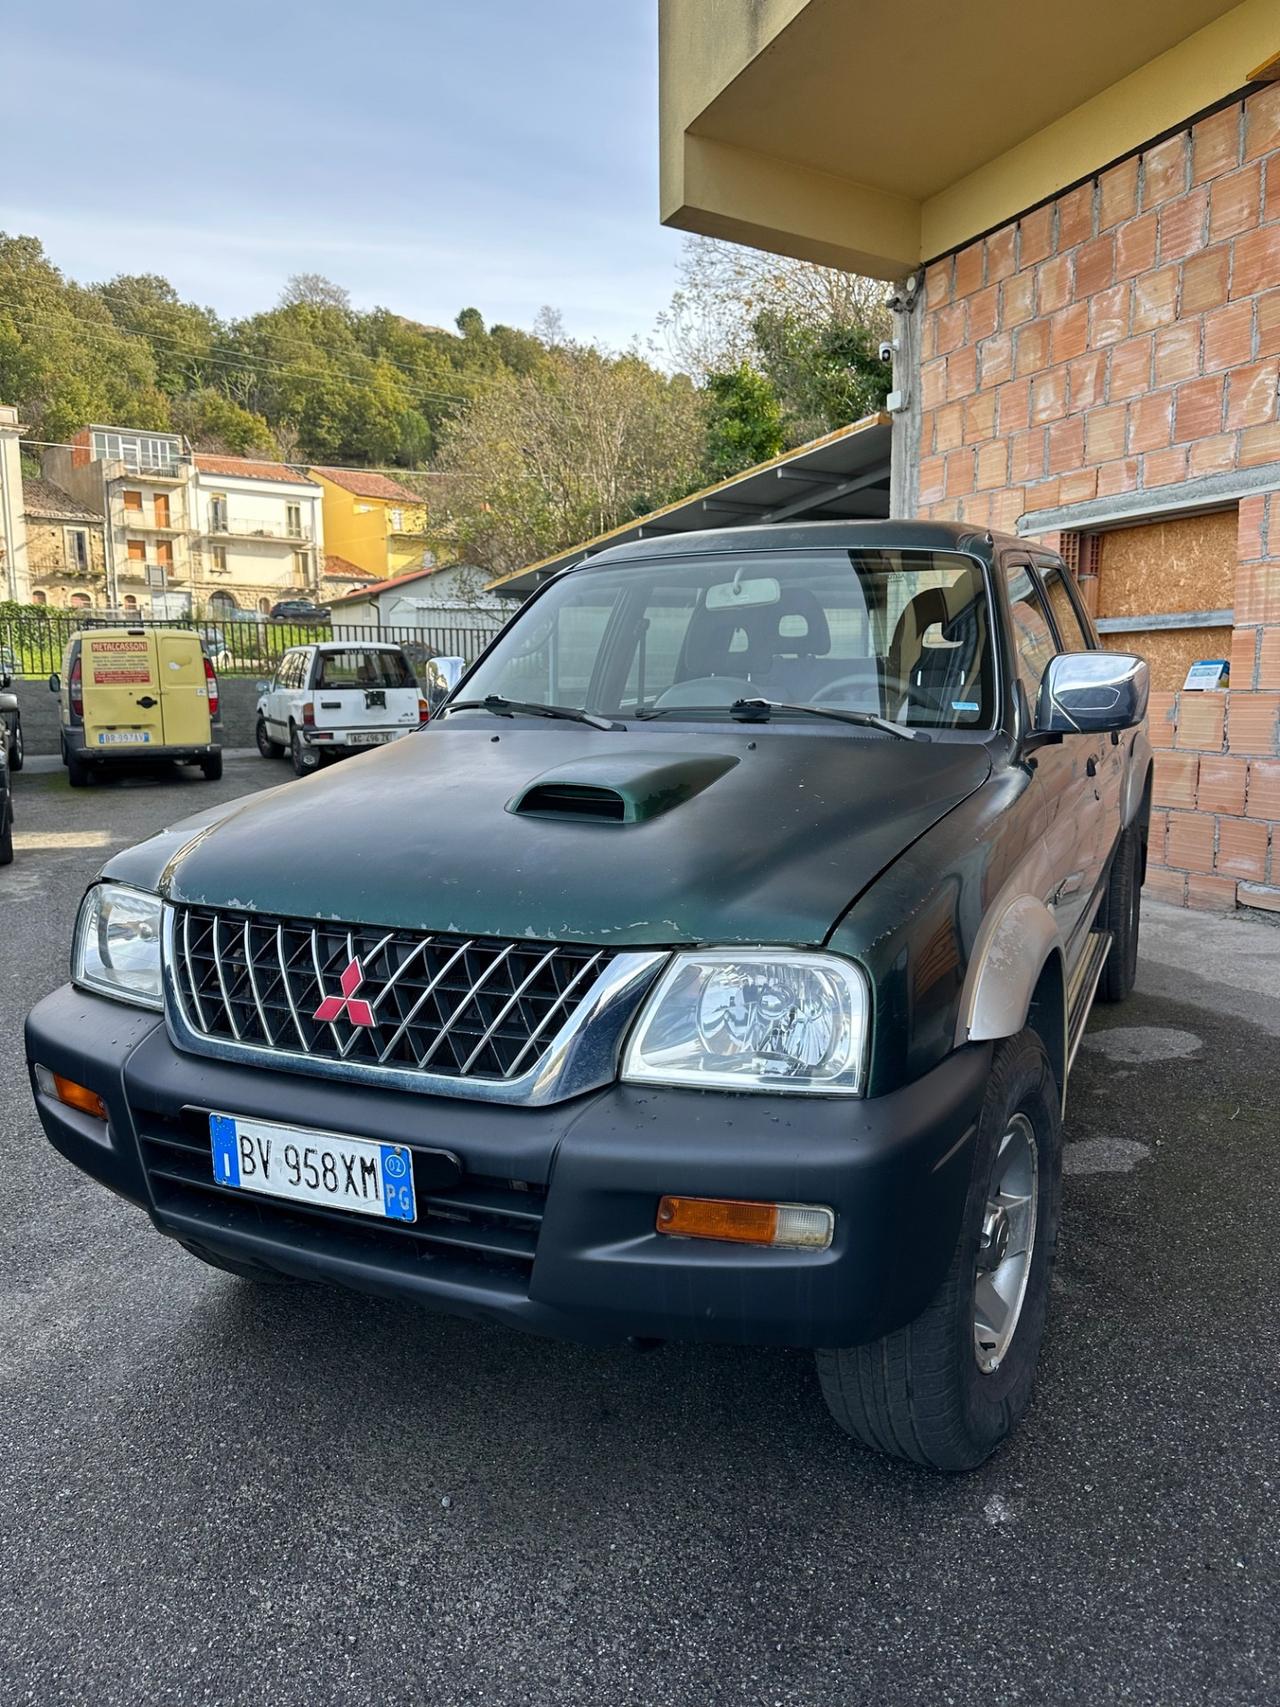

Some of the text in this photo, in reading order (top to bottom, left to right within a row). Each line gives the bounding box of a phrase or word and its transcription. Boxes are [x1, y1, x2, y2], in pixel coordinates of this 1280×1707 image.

[92, 642, 146, 651] METALCASSONI
[239, 1135, 381, 1200] BV 958XM
[388, 1159, 402, 1172] 02
[385, 1183, 410, 1211] PG
